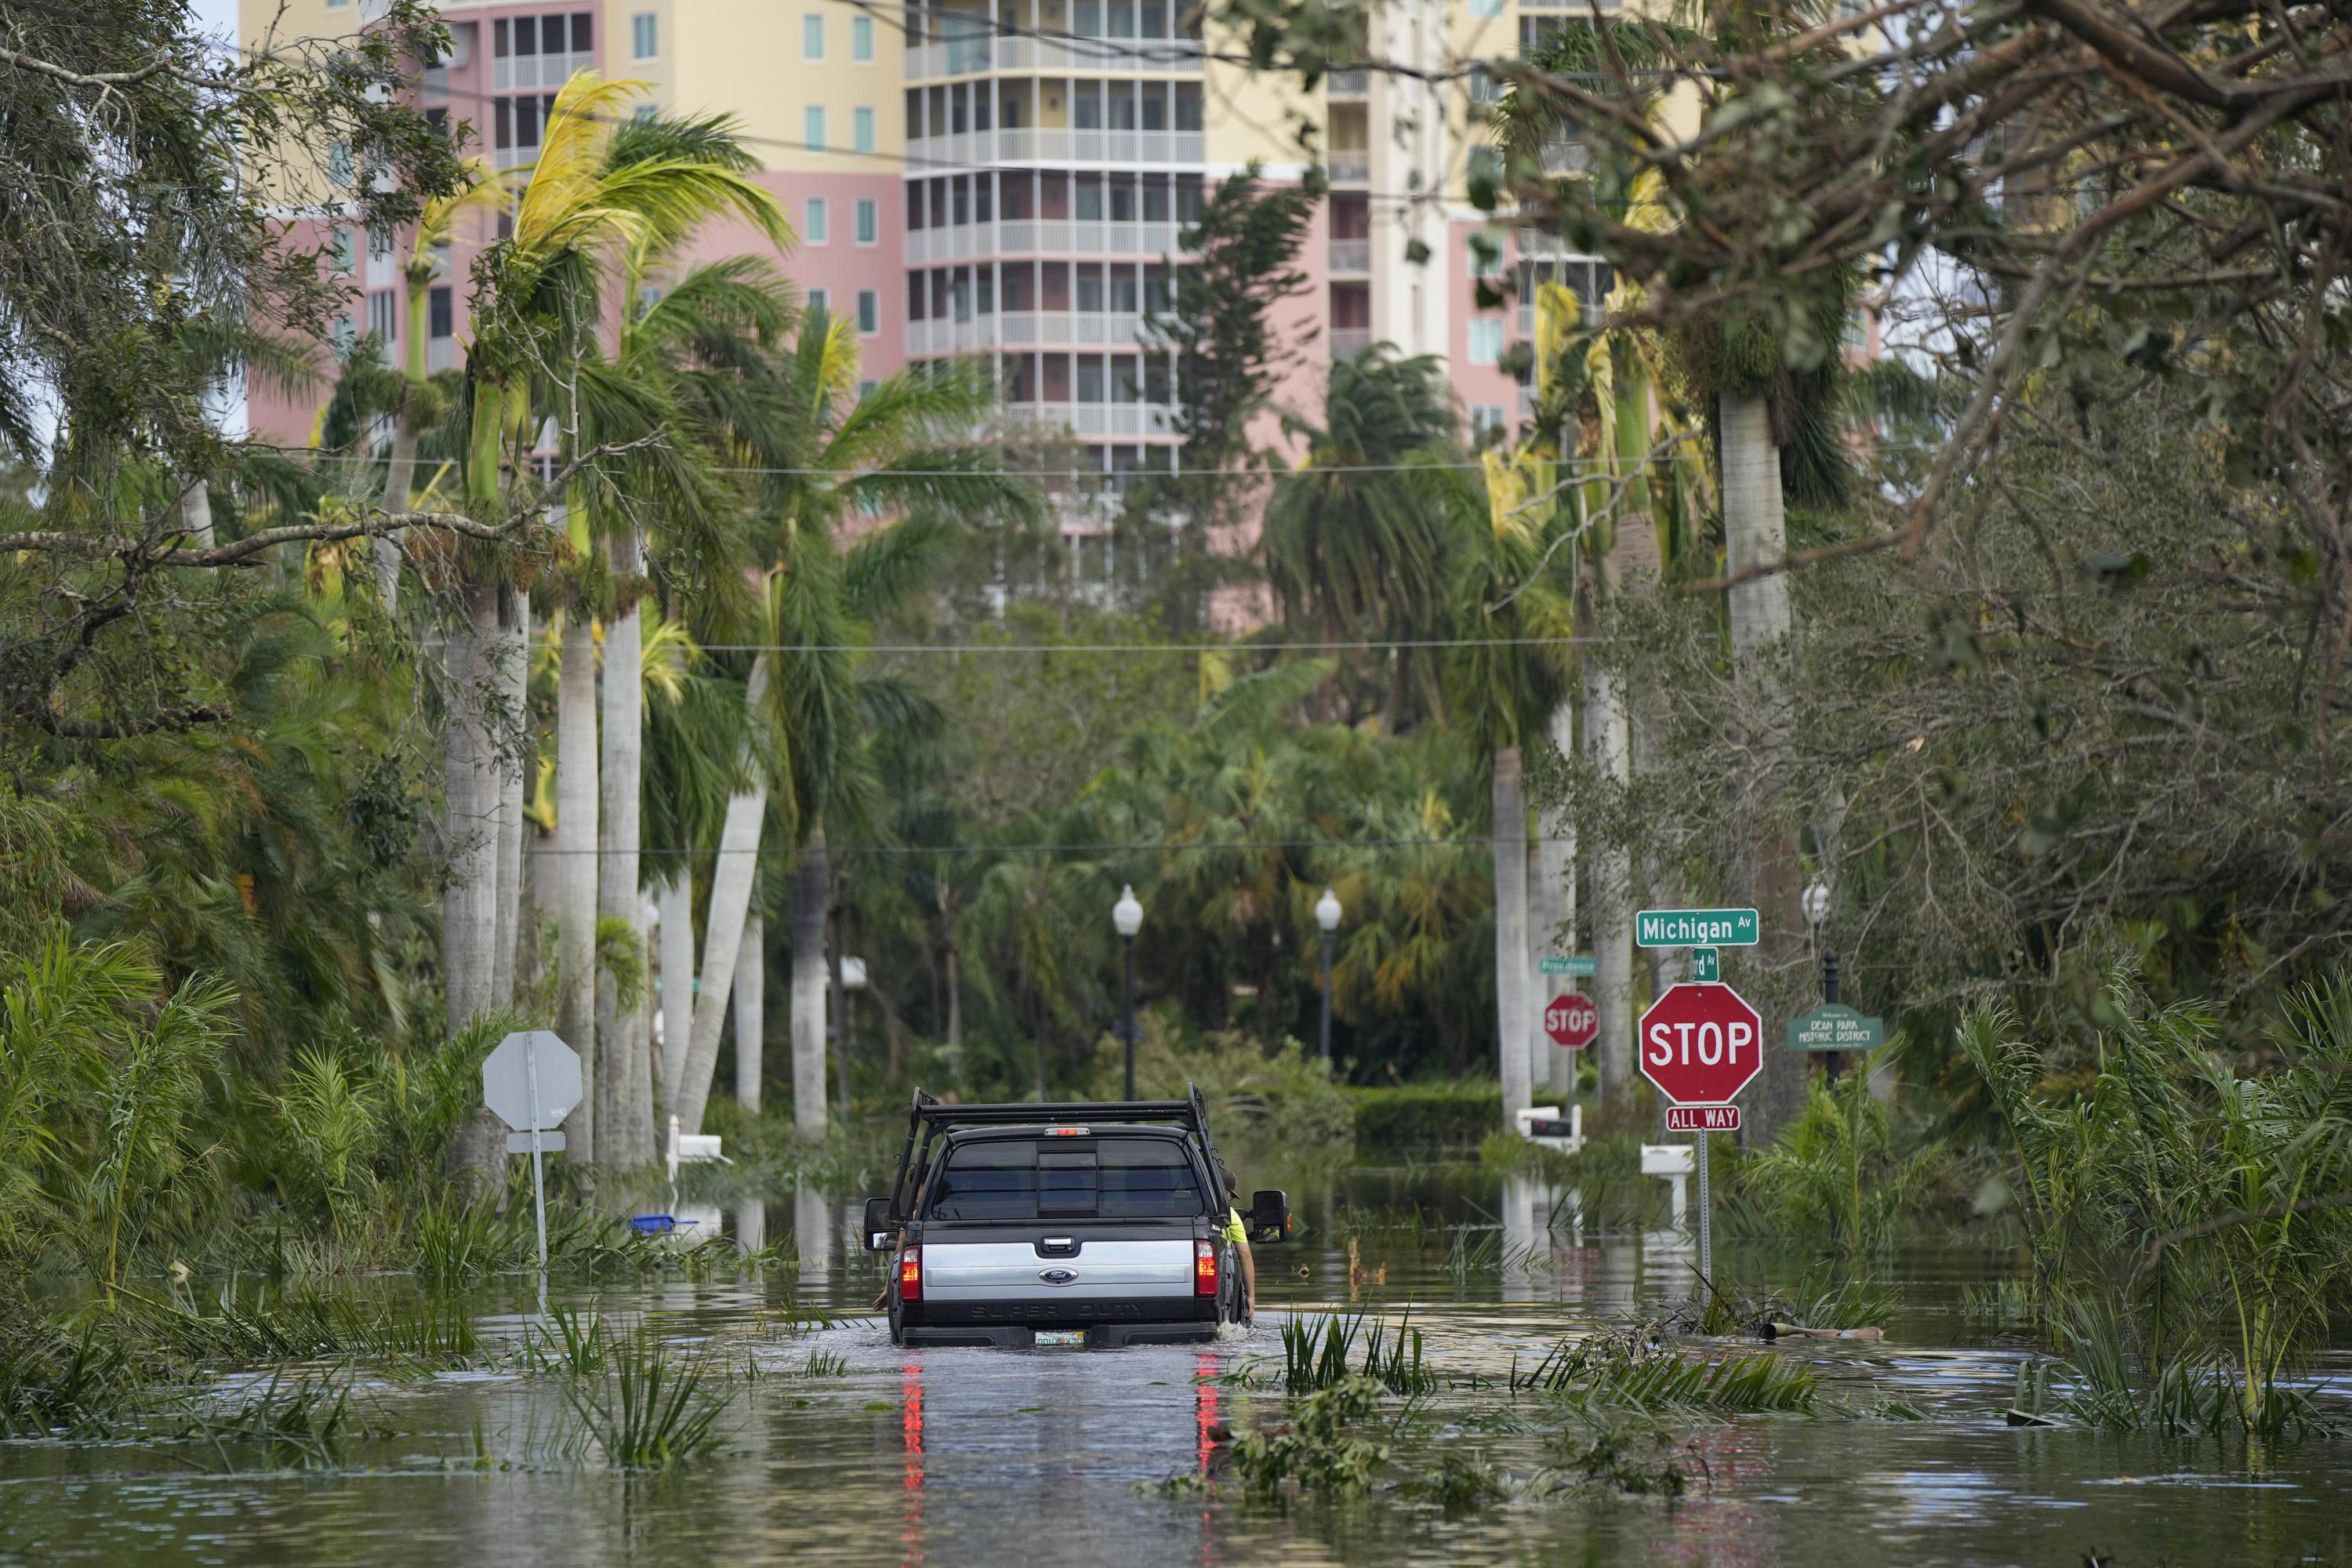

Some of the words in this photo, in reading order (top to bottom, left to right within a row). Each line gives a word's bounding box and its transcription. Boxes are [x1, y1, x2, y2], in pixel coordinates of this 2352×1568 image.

[1643, 918, 1732, 944] Michigan
[1738, 916, 1751, 927] Av
[1707, 953, 1715, 965] Av
[1546, 1009, 1595, 1033] STOP
[1810, 1020, 1833, 1031] DEAN
[1837, 1019, 1859, 1030] PARK
[1649, 1022, 1752, 1066] STOP
[1798, 1031, 1834, 1043] HISTORIC
[1836, 1030, 1871, 1042] DISTRICT
[1670, 1110, 1698, 1128] ALL
[1704, 1109, 1735, 1127] WAY
[1049, 1270, 1067, 1279] Ford
[971, 1304, 1059, 1318] SUPER
[1078, 1303, 1145, 1316] DUTY
